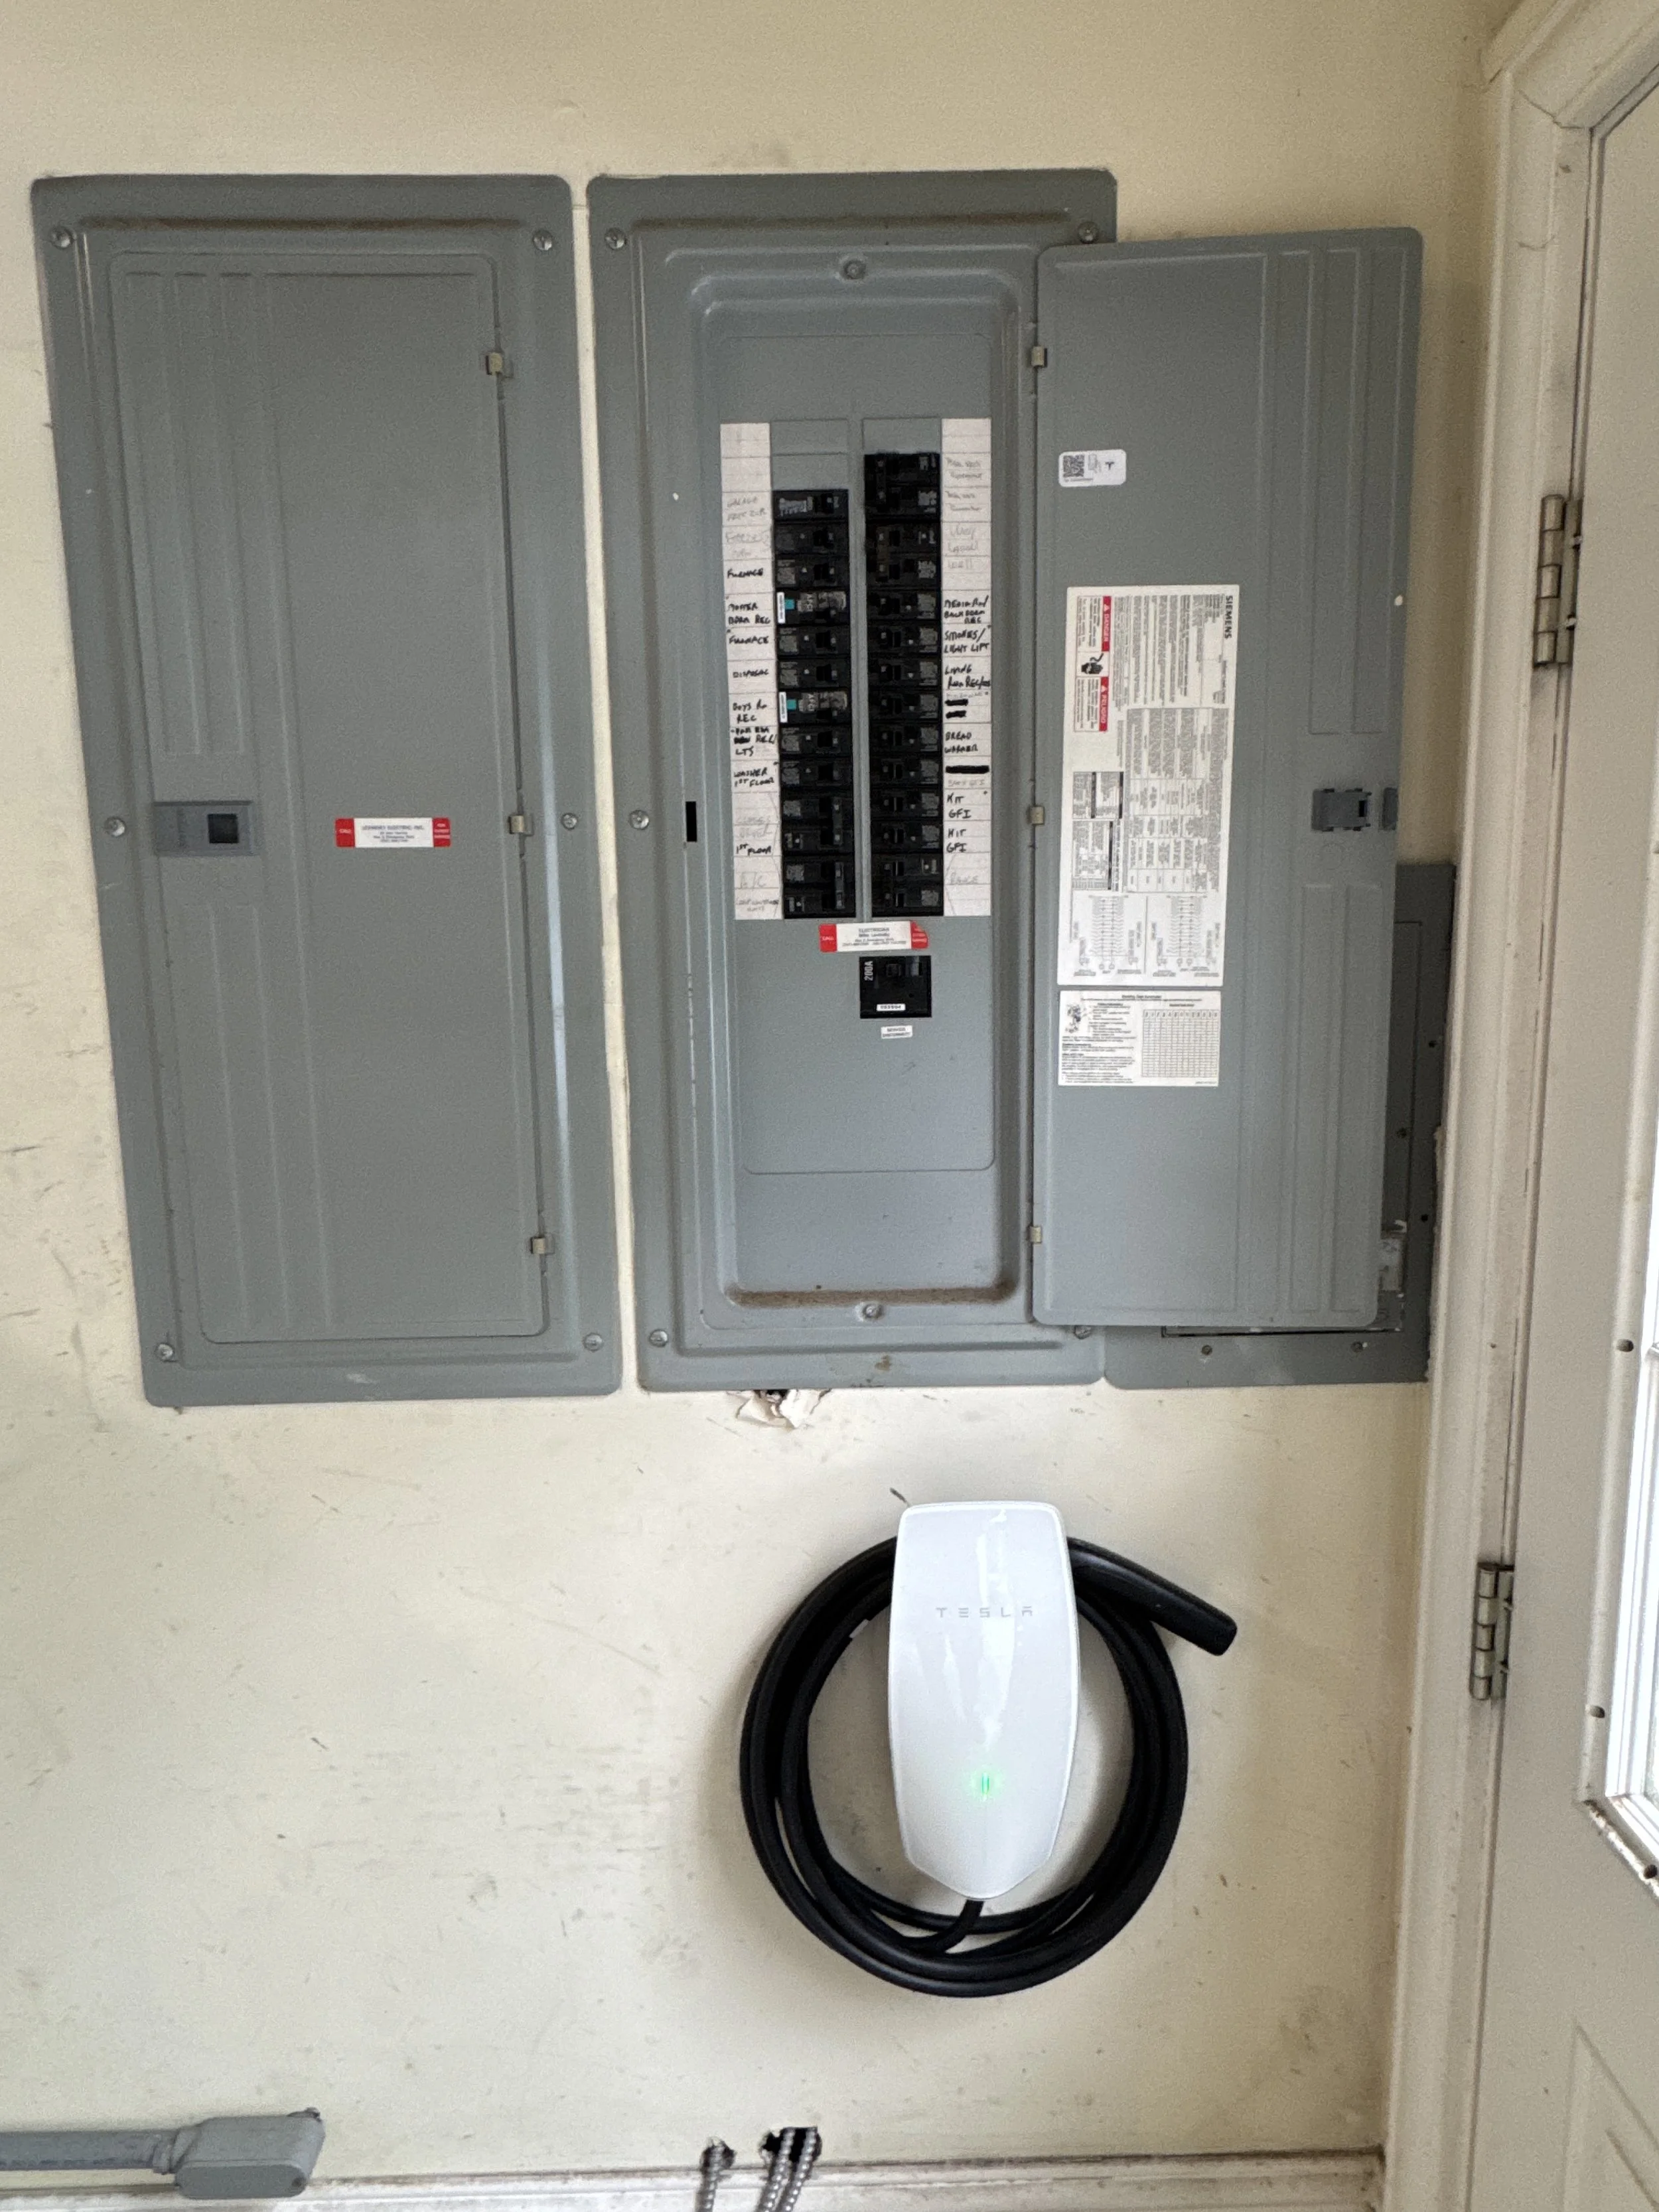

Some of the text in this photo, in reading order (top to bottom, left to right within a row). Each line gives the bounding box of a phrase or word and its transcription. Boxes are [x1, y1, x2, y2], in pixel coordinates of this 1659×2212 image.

[1224, 595, 1233, 639] SIEMENS
[948, 808, 972, 819] GFI
[946, 842, 967, 853] GFI
[863, 960, 874, 982] 200A
[935, 1606, 1033, 1618] TESLA
